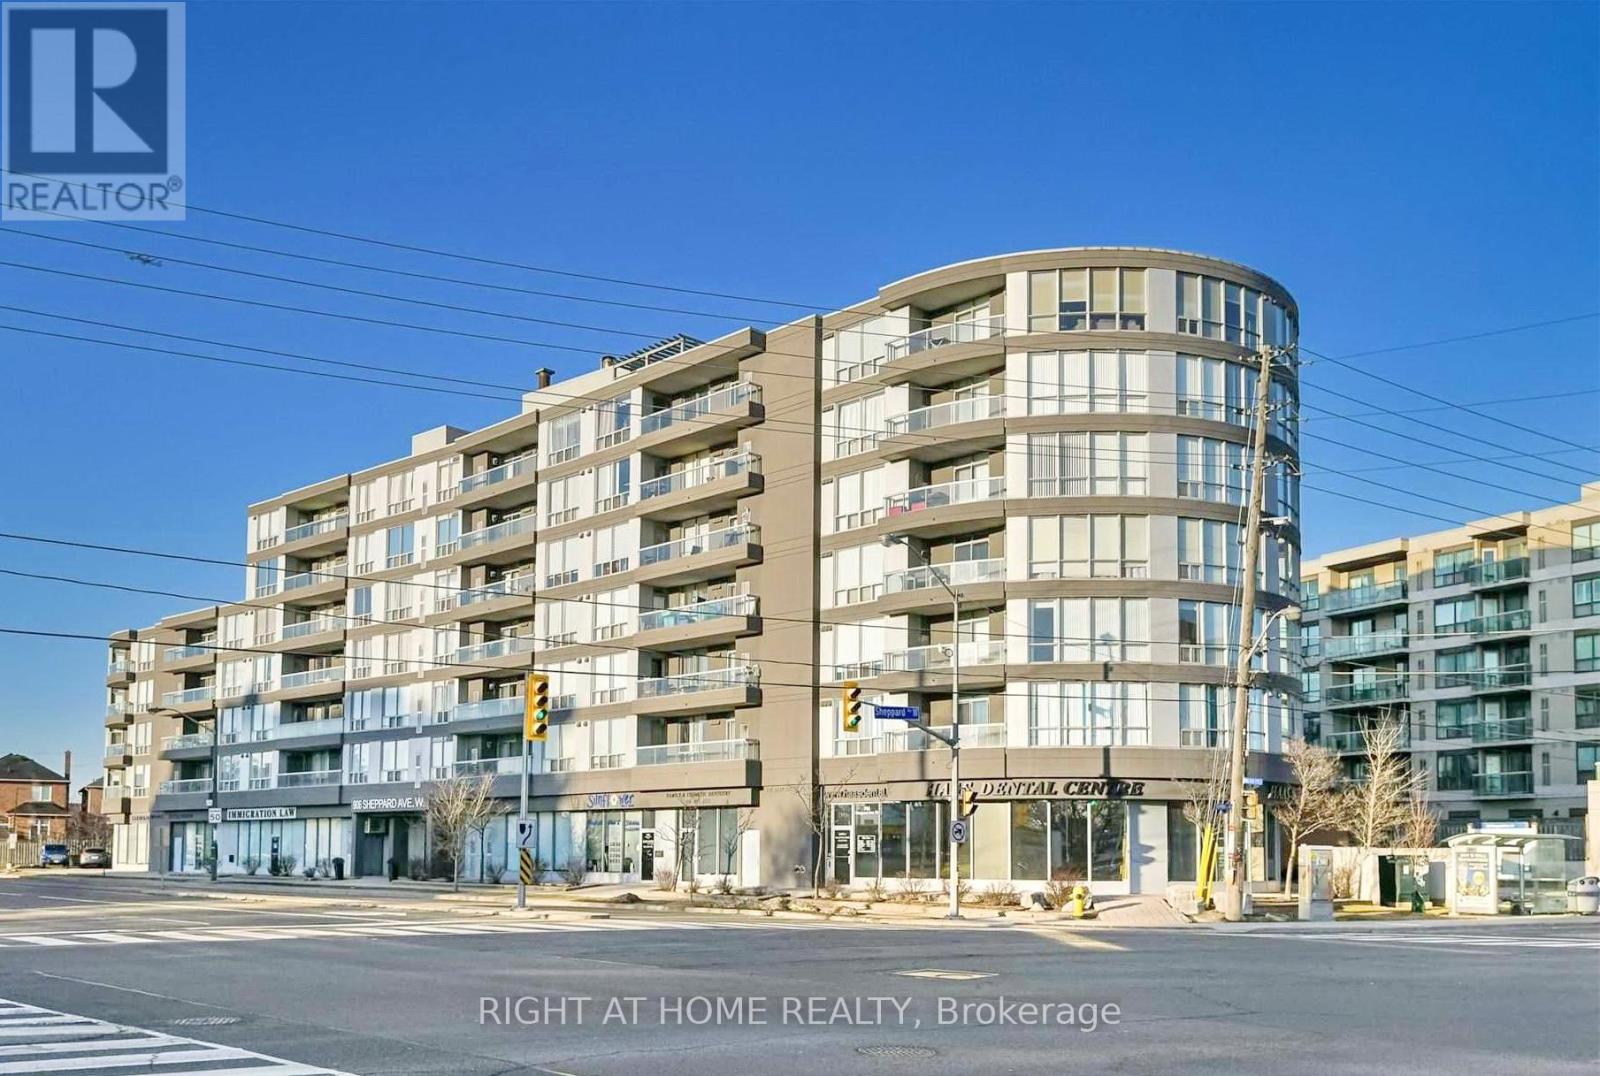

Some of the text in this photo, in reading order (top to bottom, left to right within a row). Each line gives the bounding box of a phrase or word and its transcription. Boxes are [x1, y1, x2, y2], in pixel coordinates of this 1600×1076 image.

[875, 707, 906, 718] Sheppard
[926, 780, 1146, 797] HAS DENTAL CENTRE
[362, 798, 397, 809] SHEPPARD
[210, 813, 220, 821] 50
[228, 807, 295, 819] IMMIGRATION LAW
